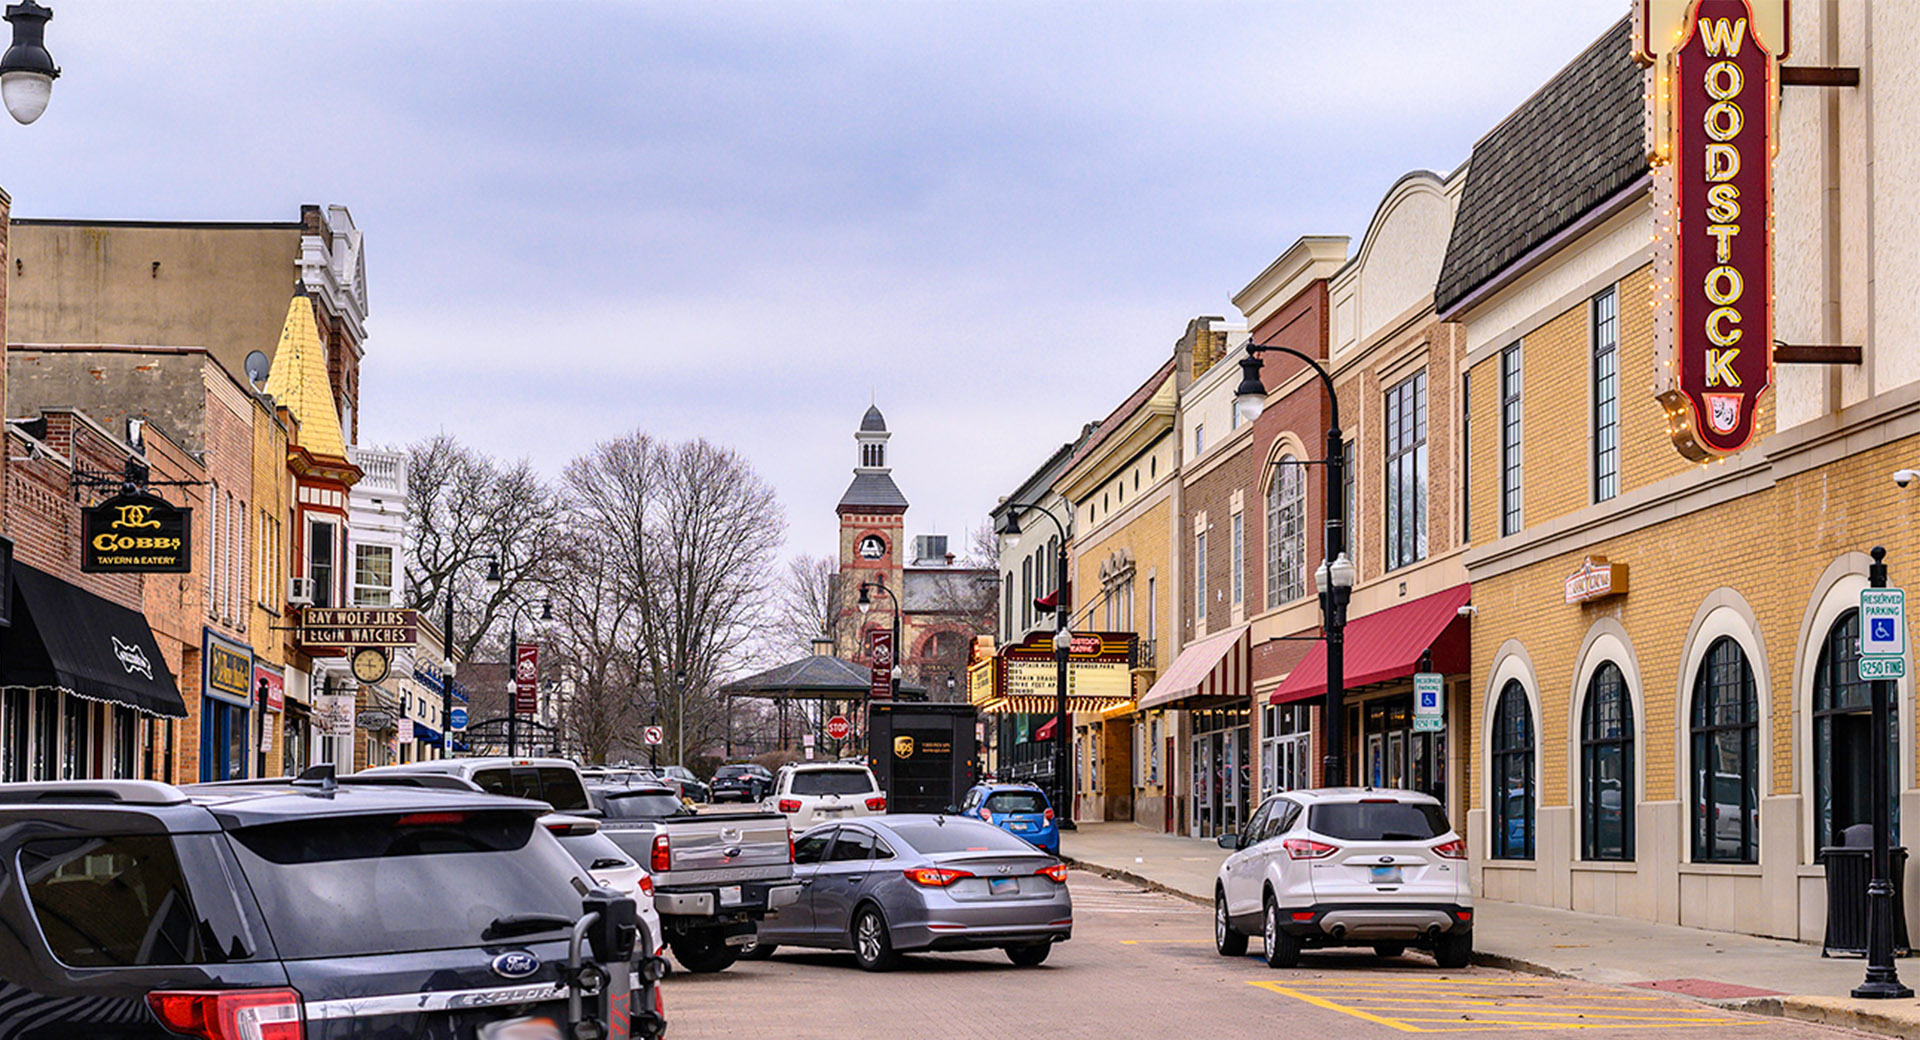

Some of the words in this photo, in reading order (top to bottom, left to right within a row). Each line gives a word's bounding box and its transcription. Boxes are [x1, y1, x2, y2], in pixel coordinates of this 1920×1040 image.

[1698, 17, 1746, 388] WOODSTOCK
[97, 556, 132, 565] TAVERN
[133, 556, 140, 565] &
[141, 556, 176, 565] EATERY
[1862, 594, 1902, 604] RESERVED
[1866, 606, 1900, 616] PARKING
[308, 611, 332, 624] RAY
[337, 612, 370, 624] WOLF
[373, 612, 407, 625] JLRS.
[310, 629, 345, 641] ELGIN
[351, 628, 406, 641] WATCHES
[1862, 661, 1883, 674] $250
[1885, 661, 1902, 674] FINE
[829, 723, 848, 733] STOP
[506, 954, 531, 971] Ford
